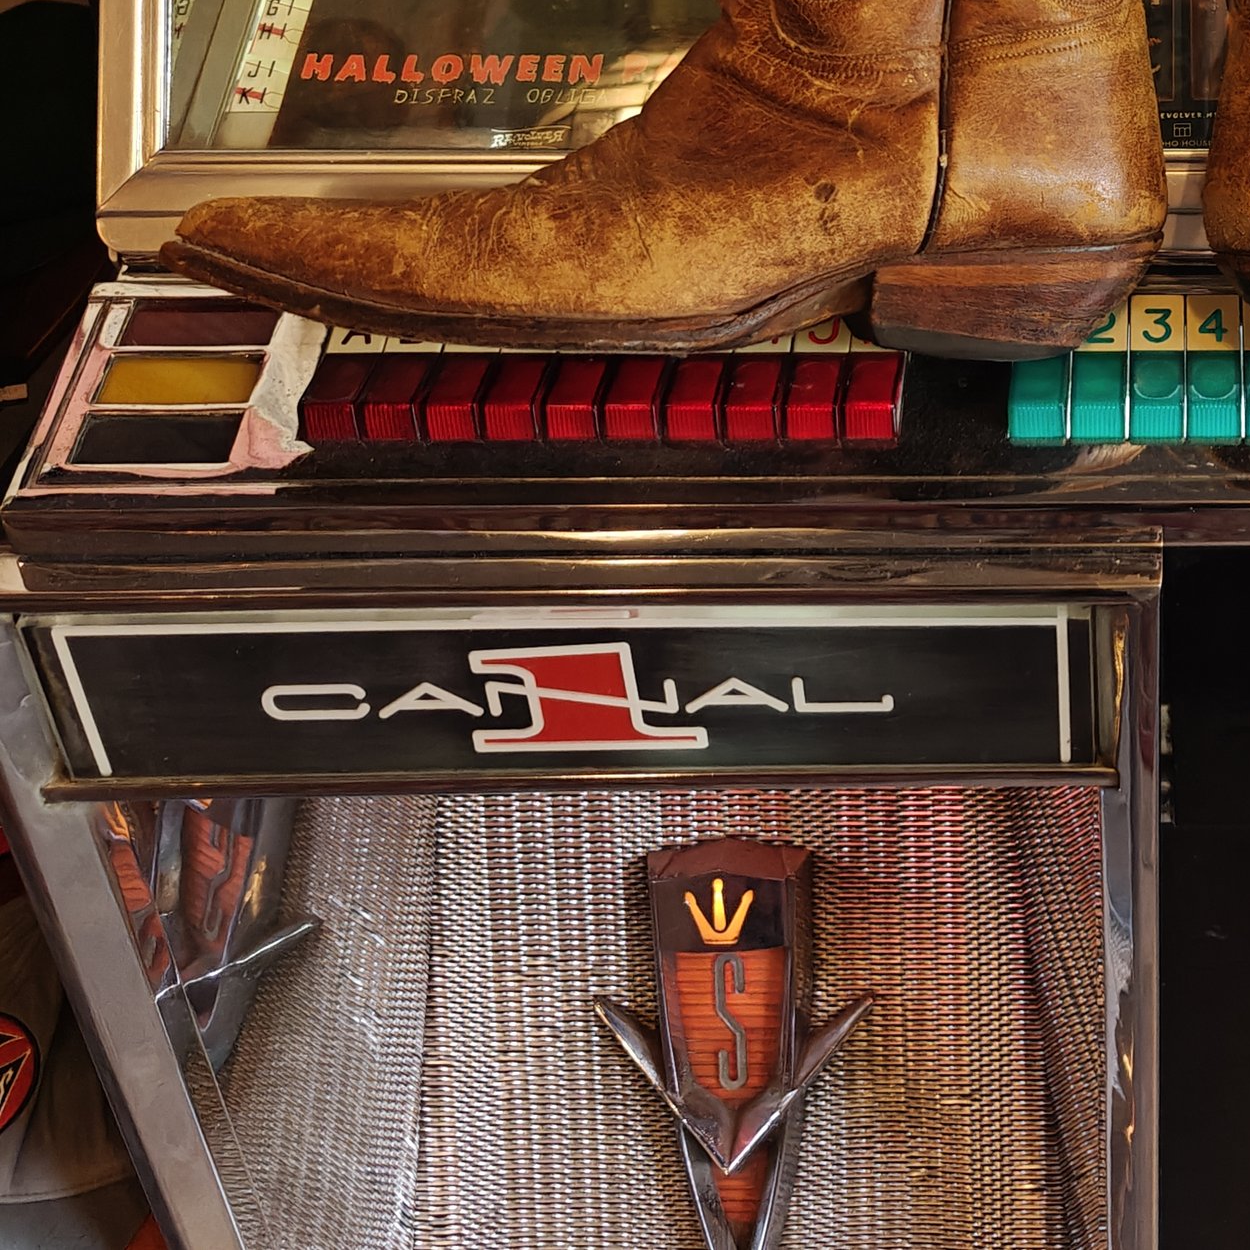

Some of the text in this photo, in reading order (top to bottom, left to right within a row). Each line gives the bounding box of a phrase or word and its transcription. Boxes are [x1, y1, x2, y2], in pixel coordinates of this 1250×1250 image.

[300, 53, 605, 86] HALLOWEEN
[394, 87, 496, 106] DISFRAZ
[1142, 308, 1172, 343] 3
[1198, 308, 1228, 342] 4
[261, 676, 895, 721] CANAL
